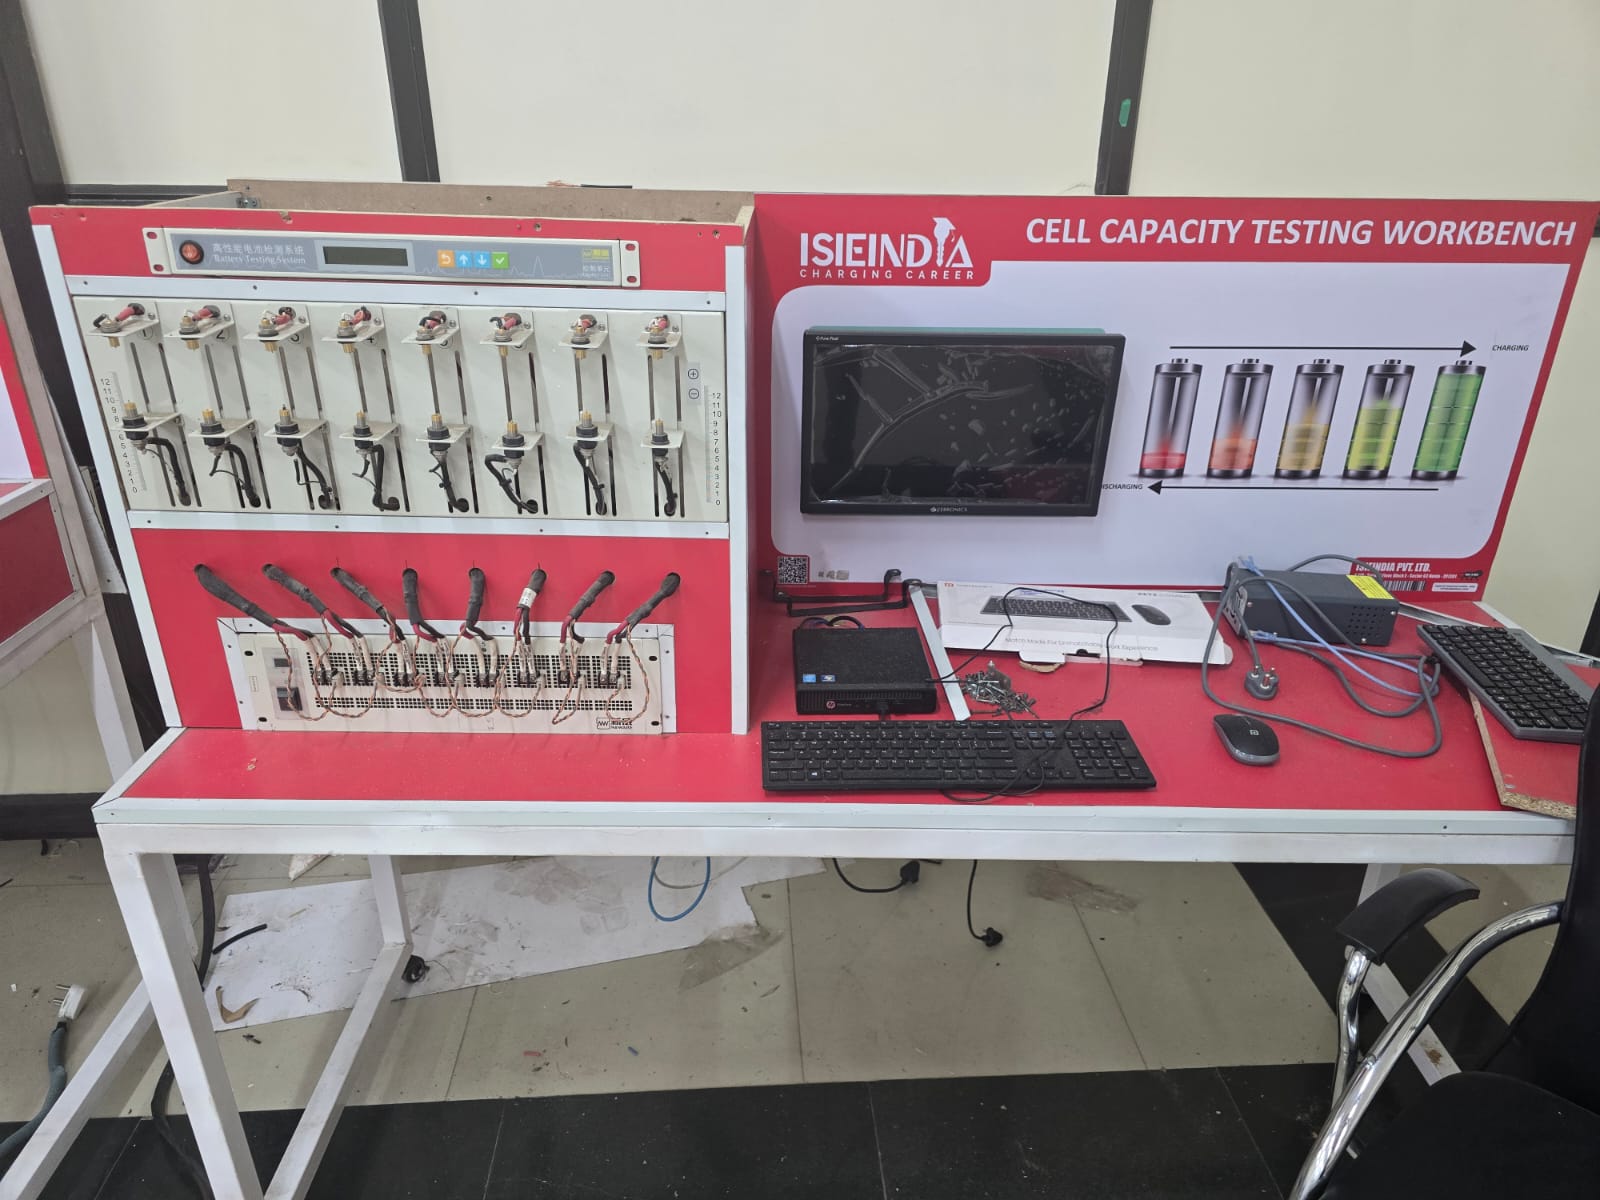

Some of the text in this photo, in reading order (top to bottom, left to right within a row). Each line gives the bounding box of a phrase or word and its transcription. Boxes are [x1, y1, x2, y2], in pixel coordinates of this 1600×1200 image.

[1026, 218, 1577, 246] CELL CAPACITY TESTING WORKBENCH
[212, 254, 306, 266] Battery Testing System
[800, 269, 974, 280] CHARGING CAREER
[1396, 562, 1414, 572] PVT.
[1414, 563, 1431, 573] LTD.
